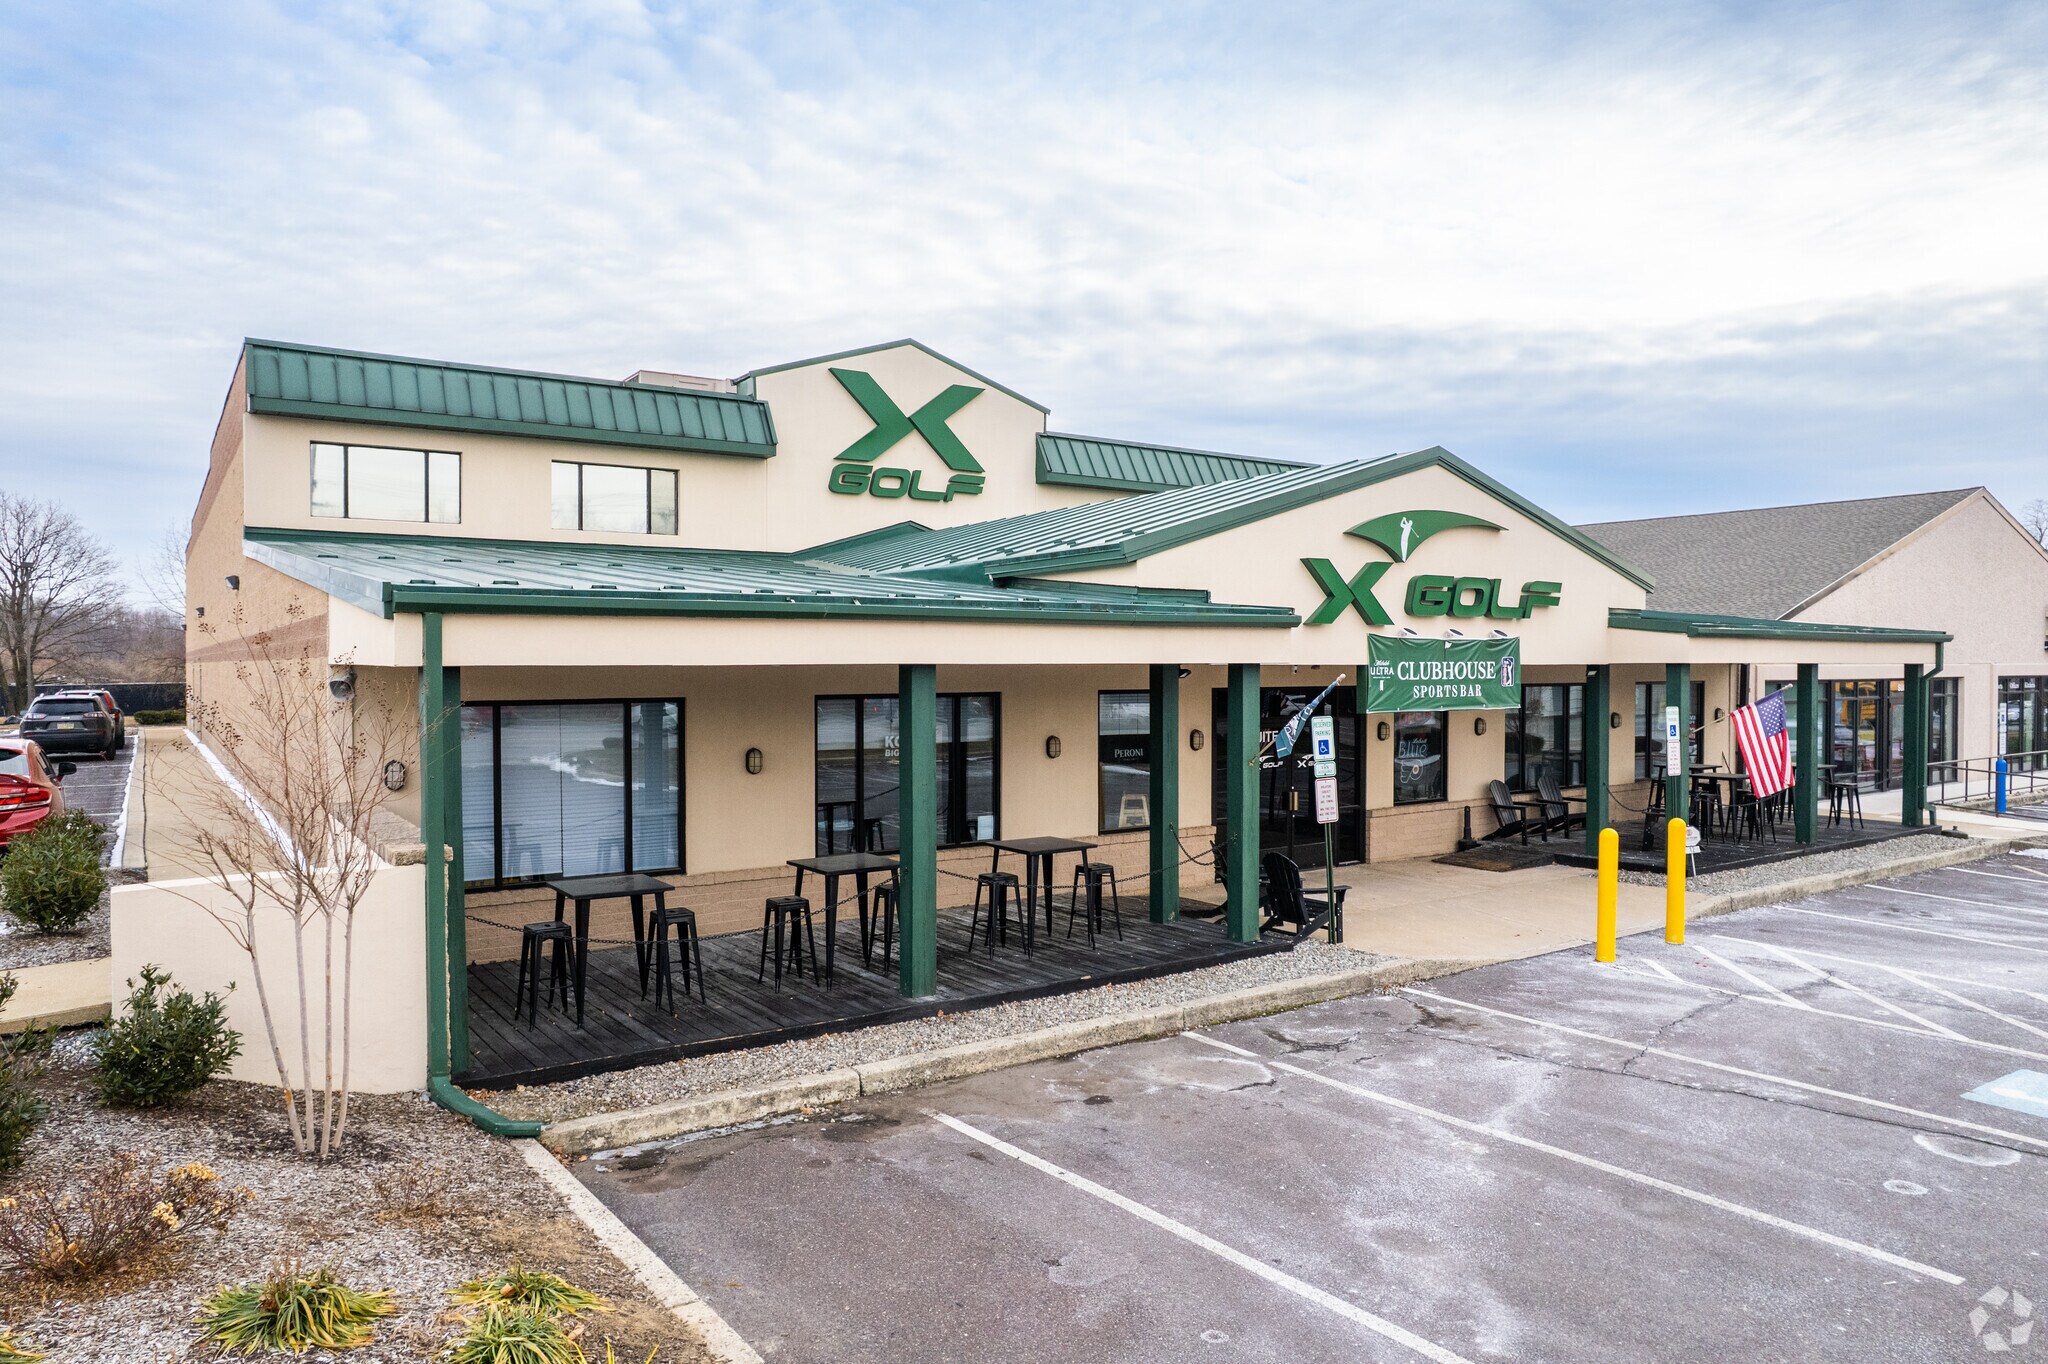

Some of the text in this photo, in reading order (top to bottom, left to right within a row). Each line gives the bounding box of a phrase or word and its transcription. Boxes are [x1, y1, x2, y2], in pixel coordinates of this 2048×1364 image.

[828, 367, 986, 473] X
[828, 463, 986, 502] GOLF
[1300, 557, 1563, 626] X GOLF
[1370, 666, 1395, 676] ULTRA
[1397, 660, 1496, 681] CLUBHOUSE
[1413, 684, 1483, 699] SPORTS BAR
[1114, 748, 1144, 758] PERONI
[1399, 741, 1428, 758] Blue
